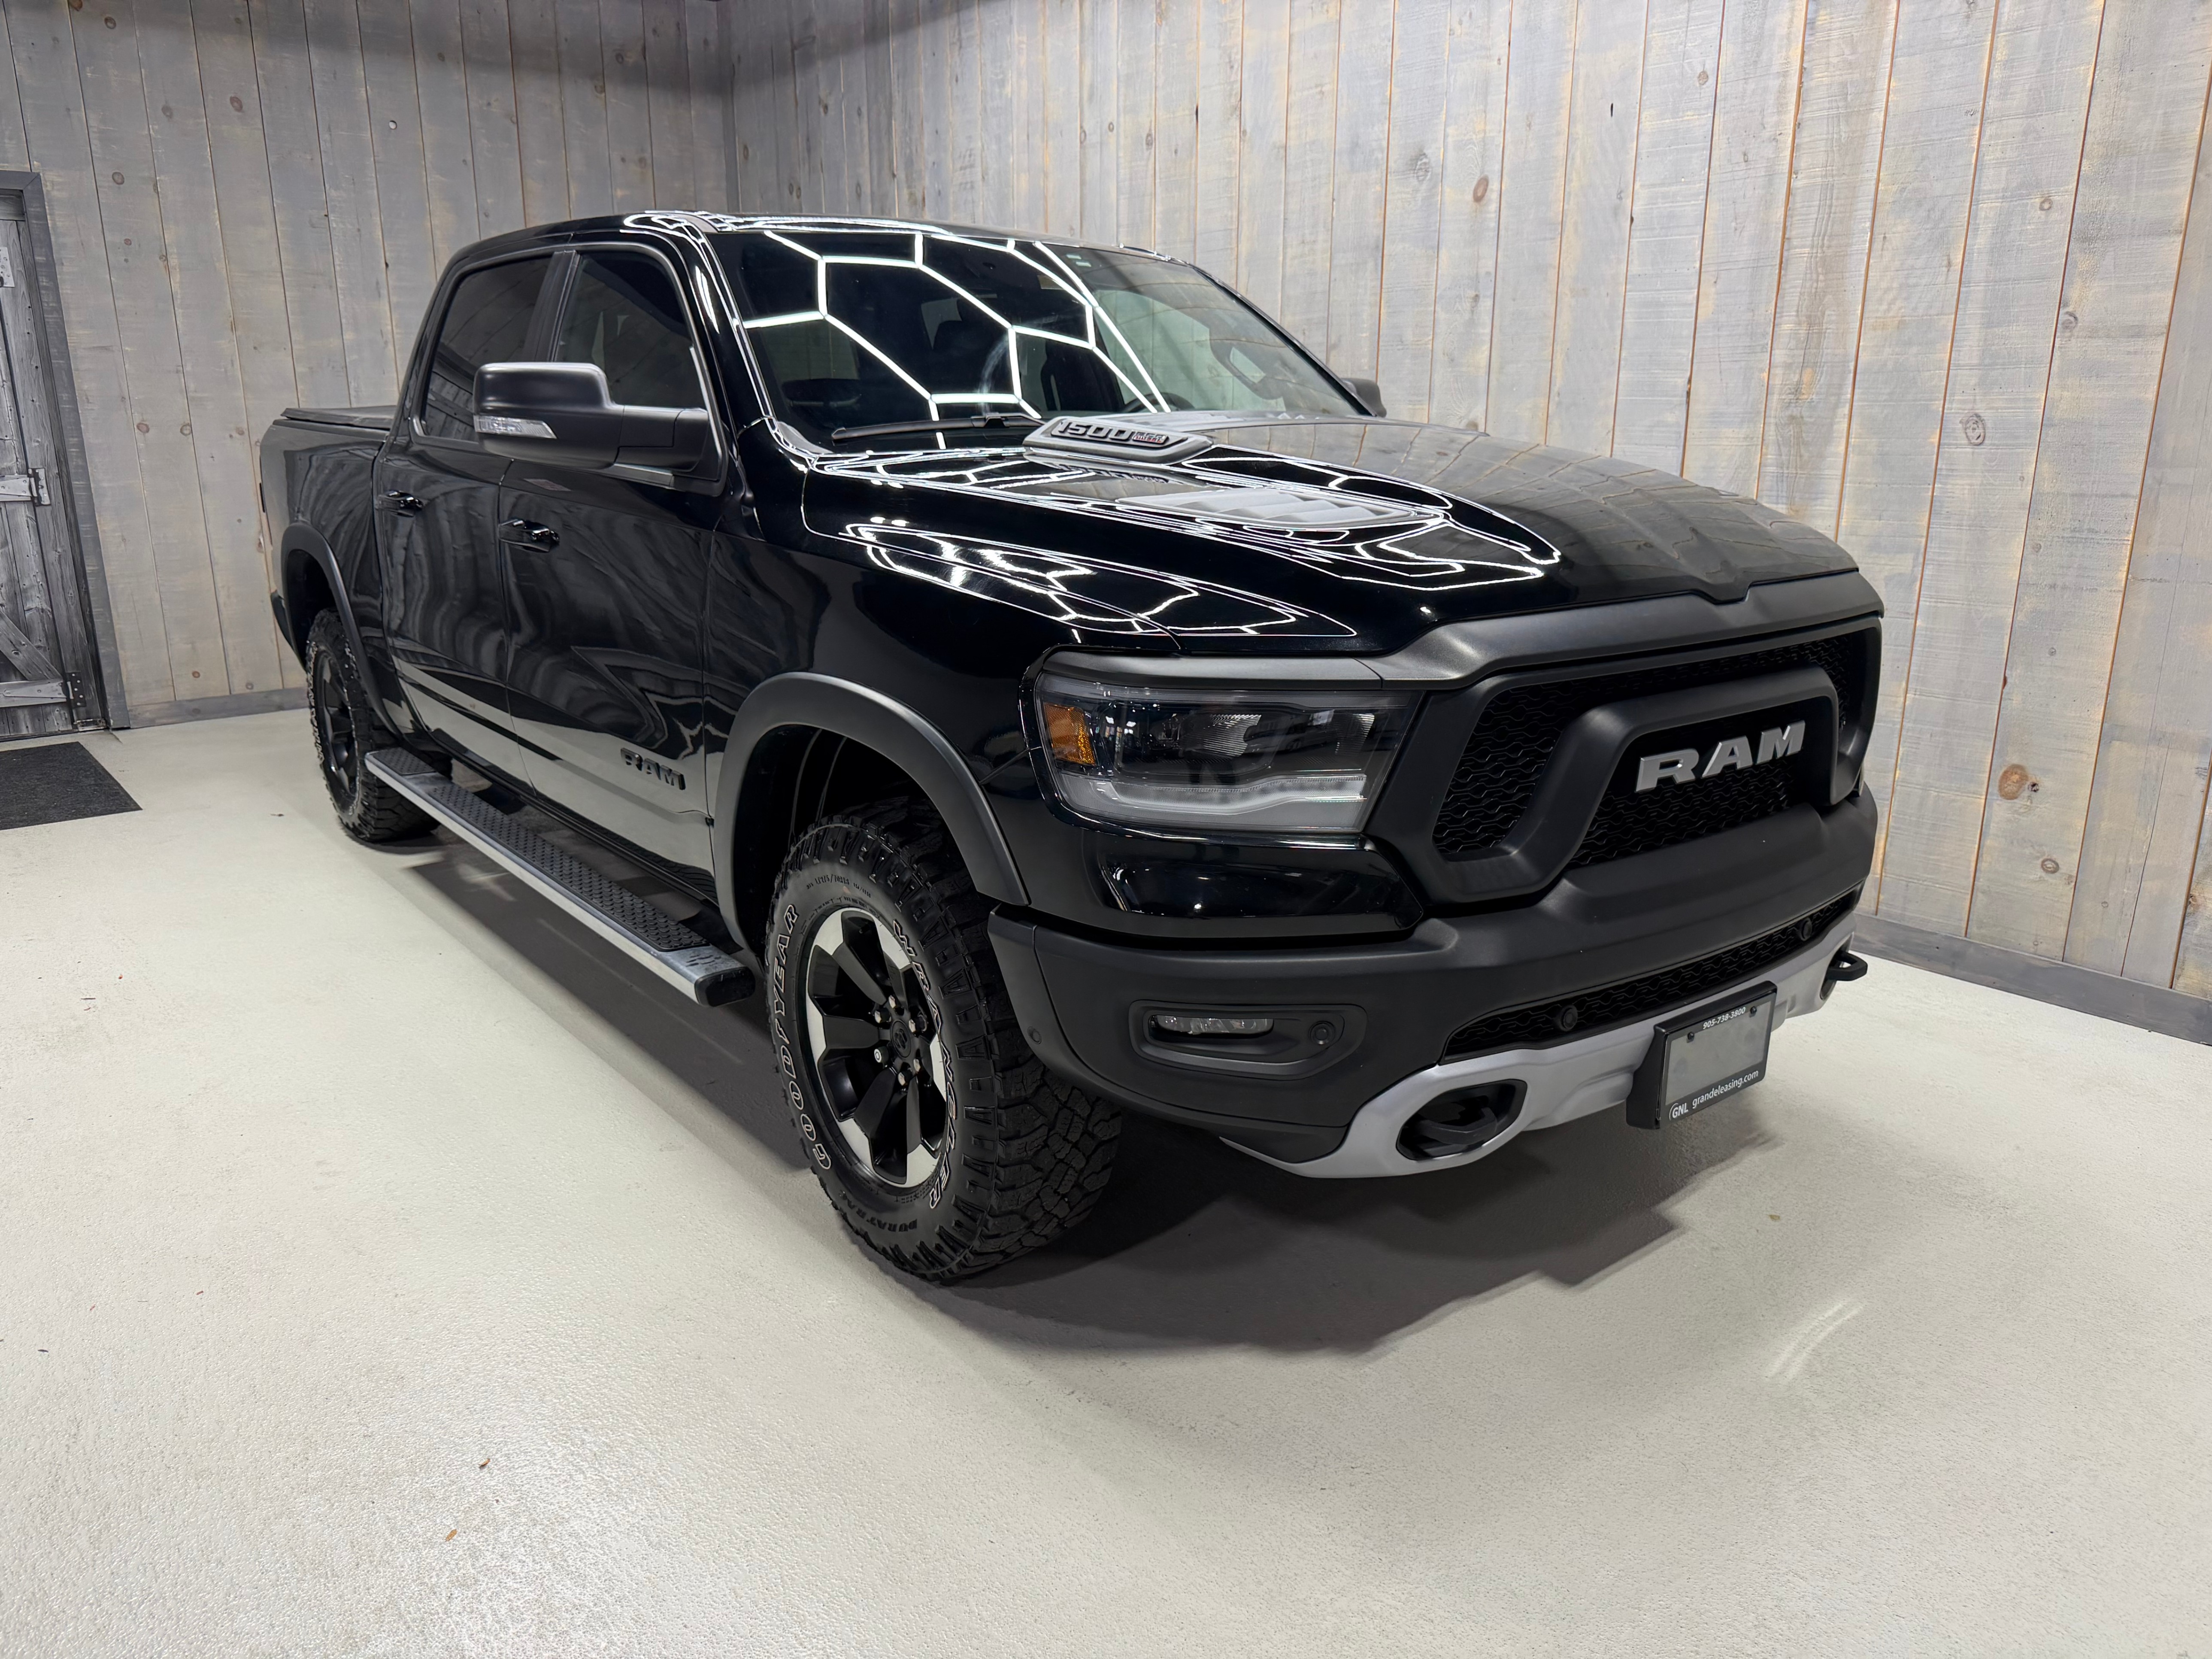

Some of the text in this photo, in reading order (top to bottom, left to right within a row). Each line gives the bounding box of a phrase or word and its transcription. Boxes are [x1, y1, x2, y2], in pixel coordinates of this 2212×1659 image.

[1058, 420, 1133, 440] 1500
[621, 748, 686, 790] RAM
[1636, 720, 1805, 793] RAM
[773, 904, 832, 1170] GOODYEAR
[1703, 1007, 1746, 1029] 905-738-3800
[893, 919, 957, 1209] WRANGLER
[1672, 1071, 1758, 1119] GNL grandeleasing.com
